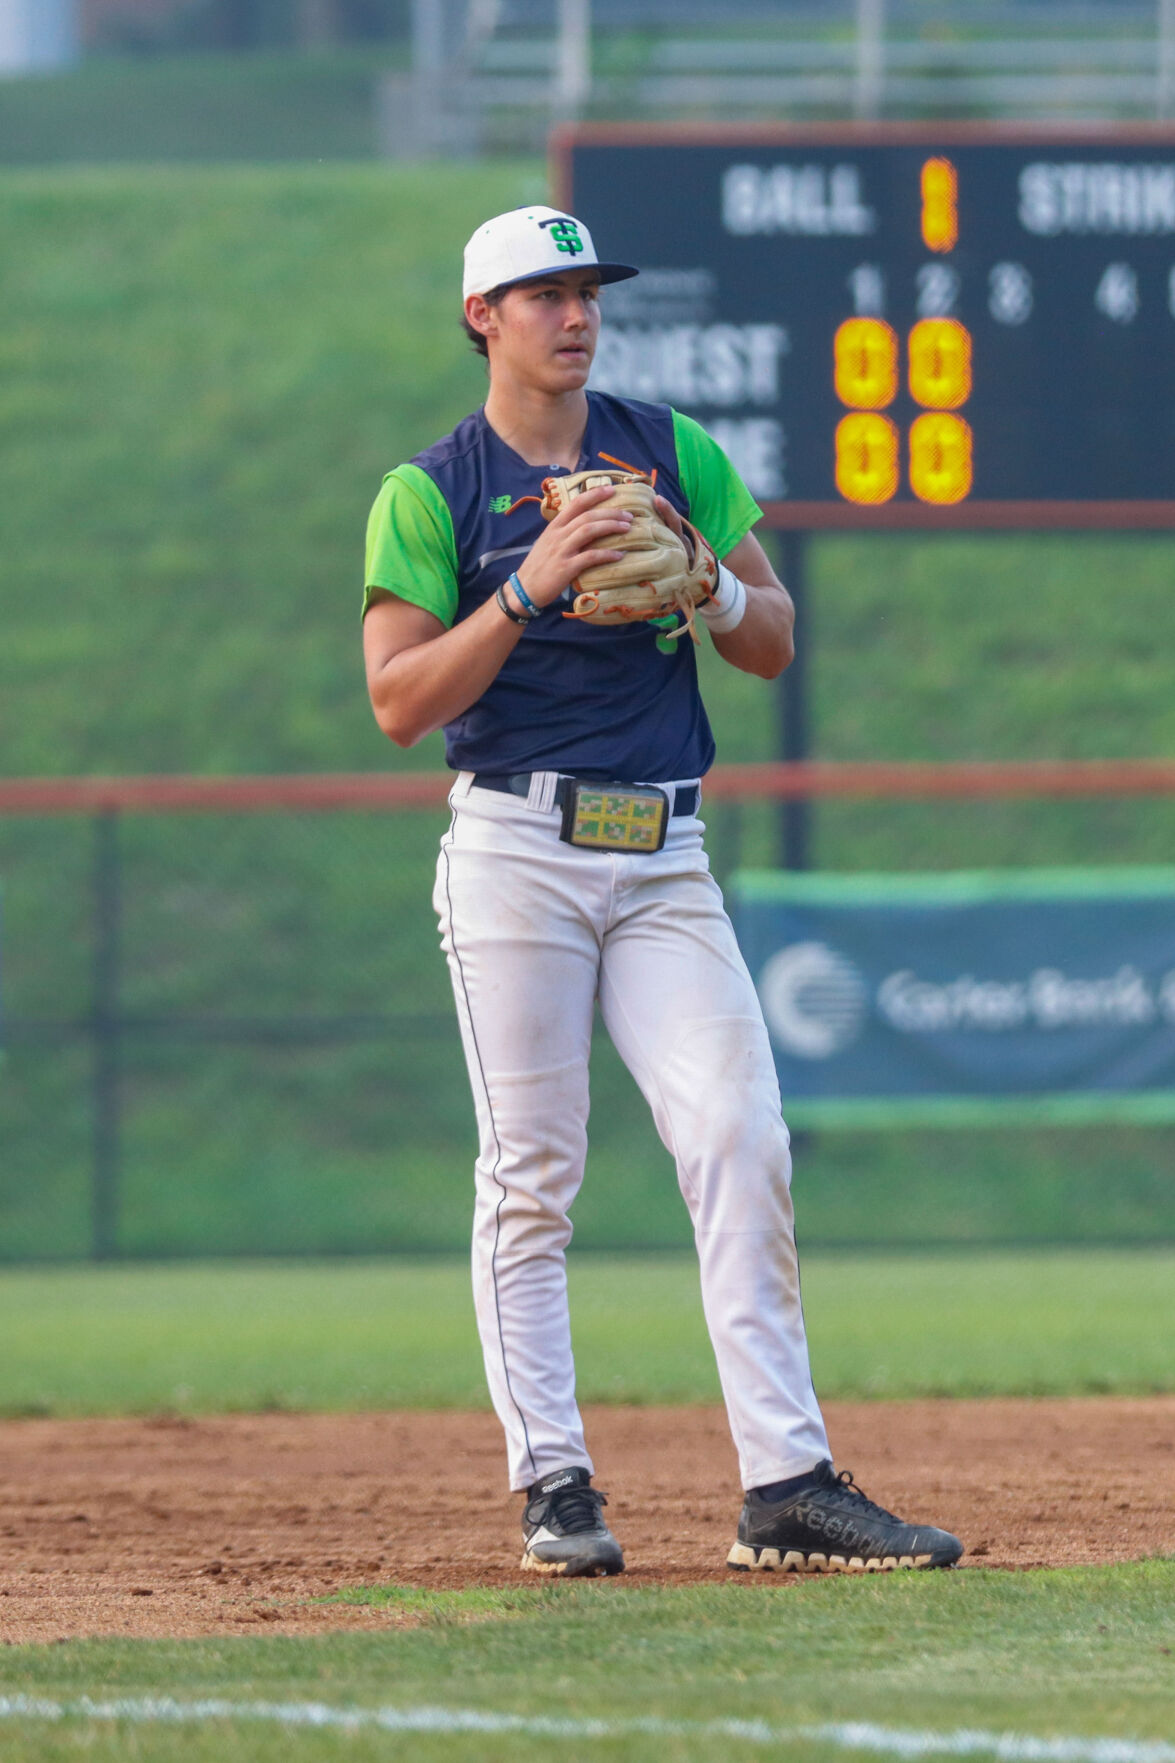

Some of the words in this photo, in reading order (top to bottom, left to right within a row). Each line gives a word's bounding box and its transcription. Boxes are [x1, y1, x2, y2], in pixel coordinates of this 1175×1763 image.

[724, 164, 874, 235] BALL
[917, 262, 958, 319] 2
[1096, 263, 1138, 323] 4
